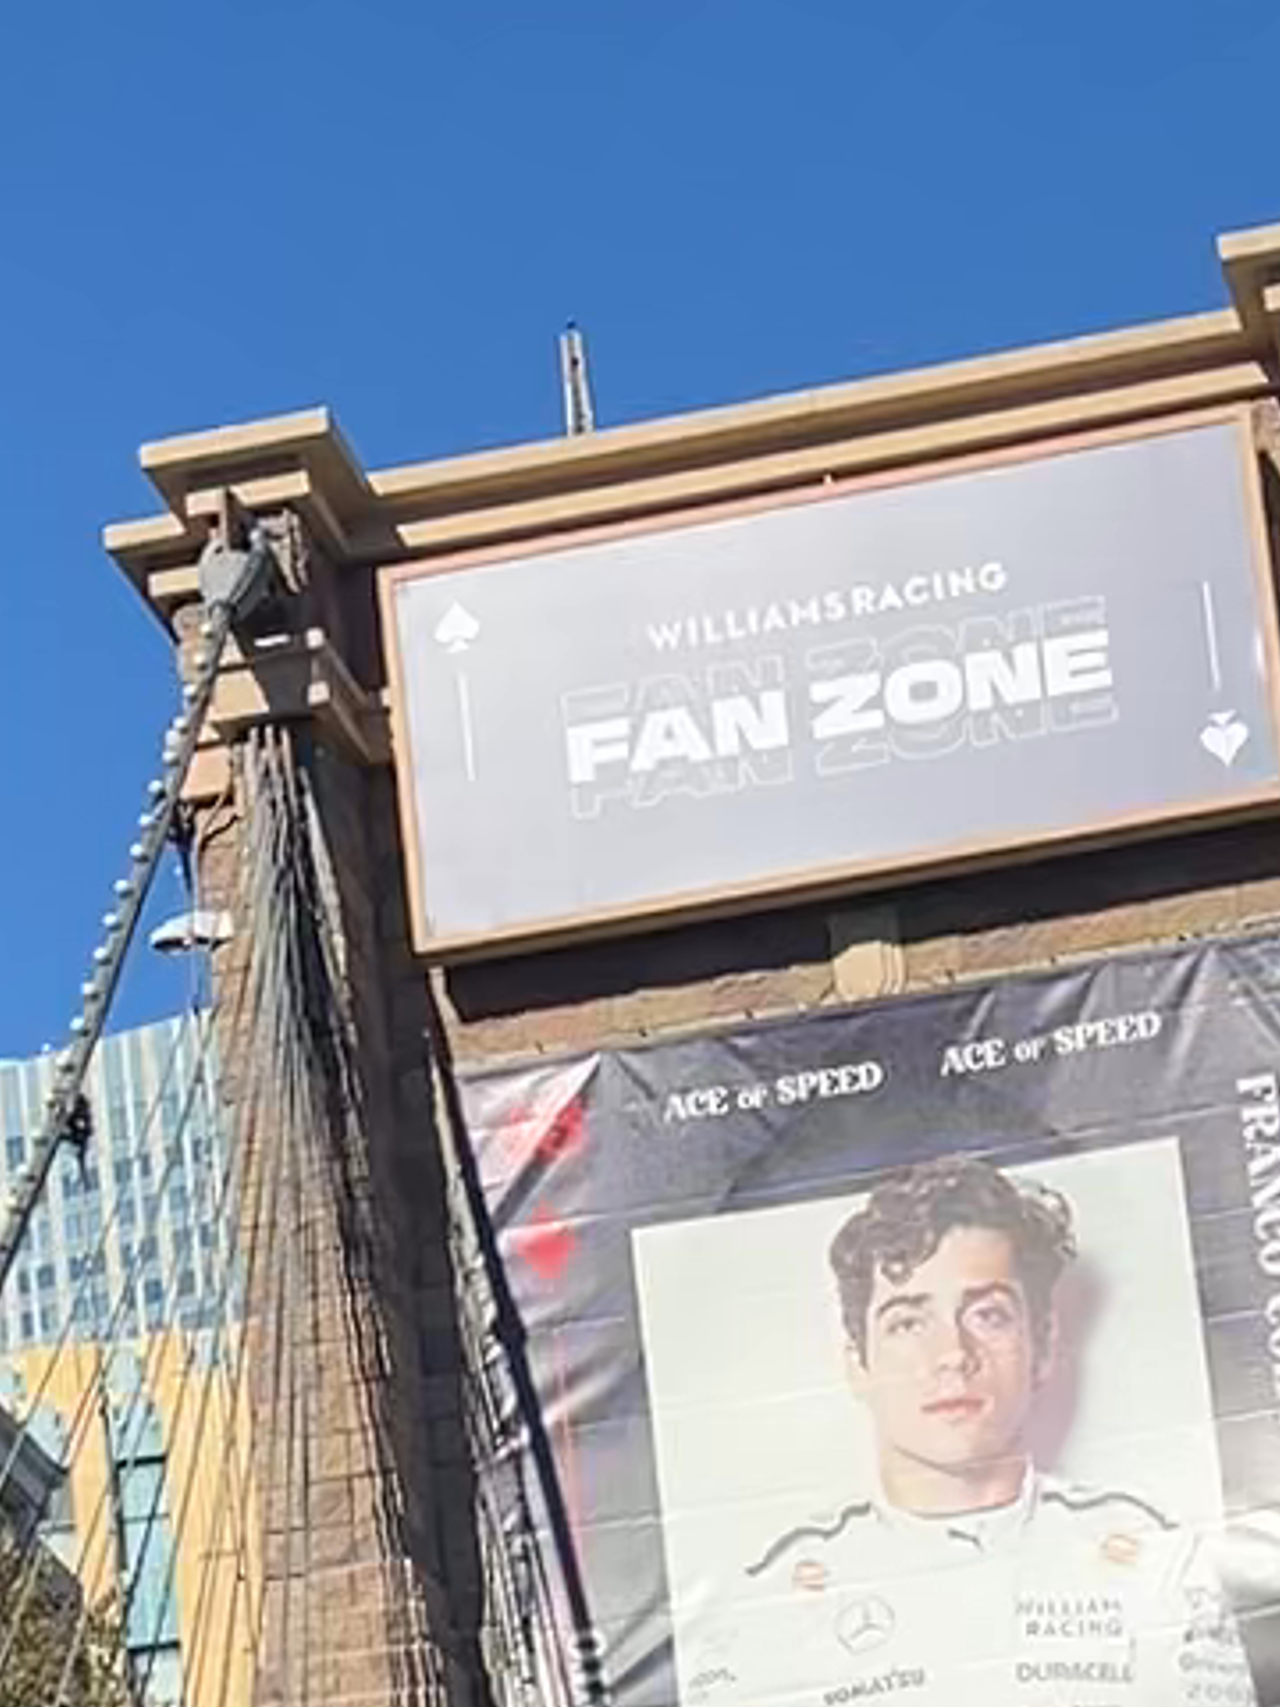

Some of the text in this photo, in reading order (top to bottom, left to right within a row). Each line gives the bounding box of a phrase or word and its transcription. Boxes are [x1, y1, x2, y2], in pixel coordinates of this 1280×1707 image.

[565, 629, 1113, 785] FAN ZONE
[941, 1039, 1007, 1076] ACE
[1054, 1012, 1163, 1054] SPEED
[663, 1087, 729, 1123] ACE
[775, 1061, 883, 1105] SPEED
